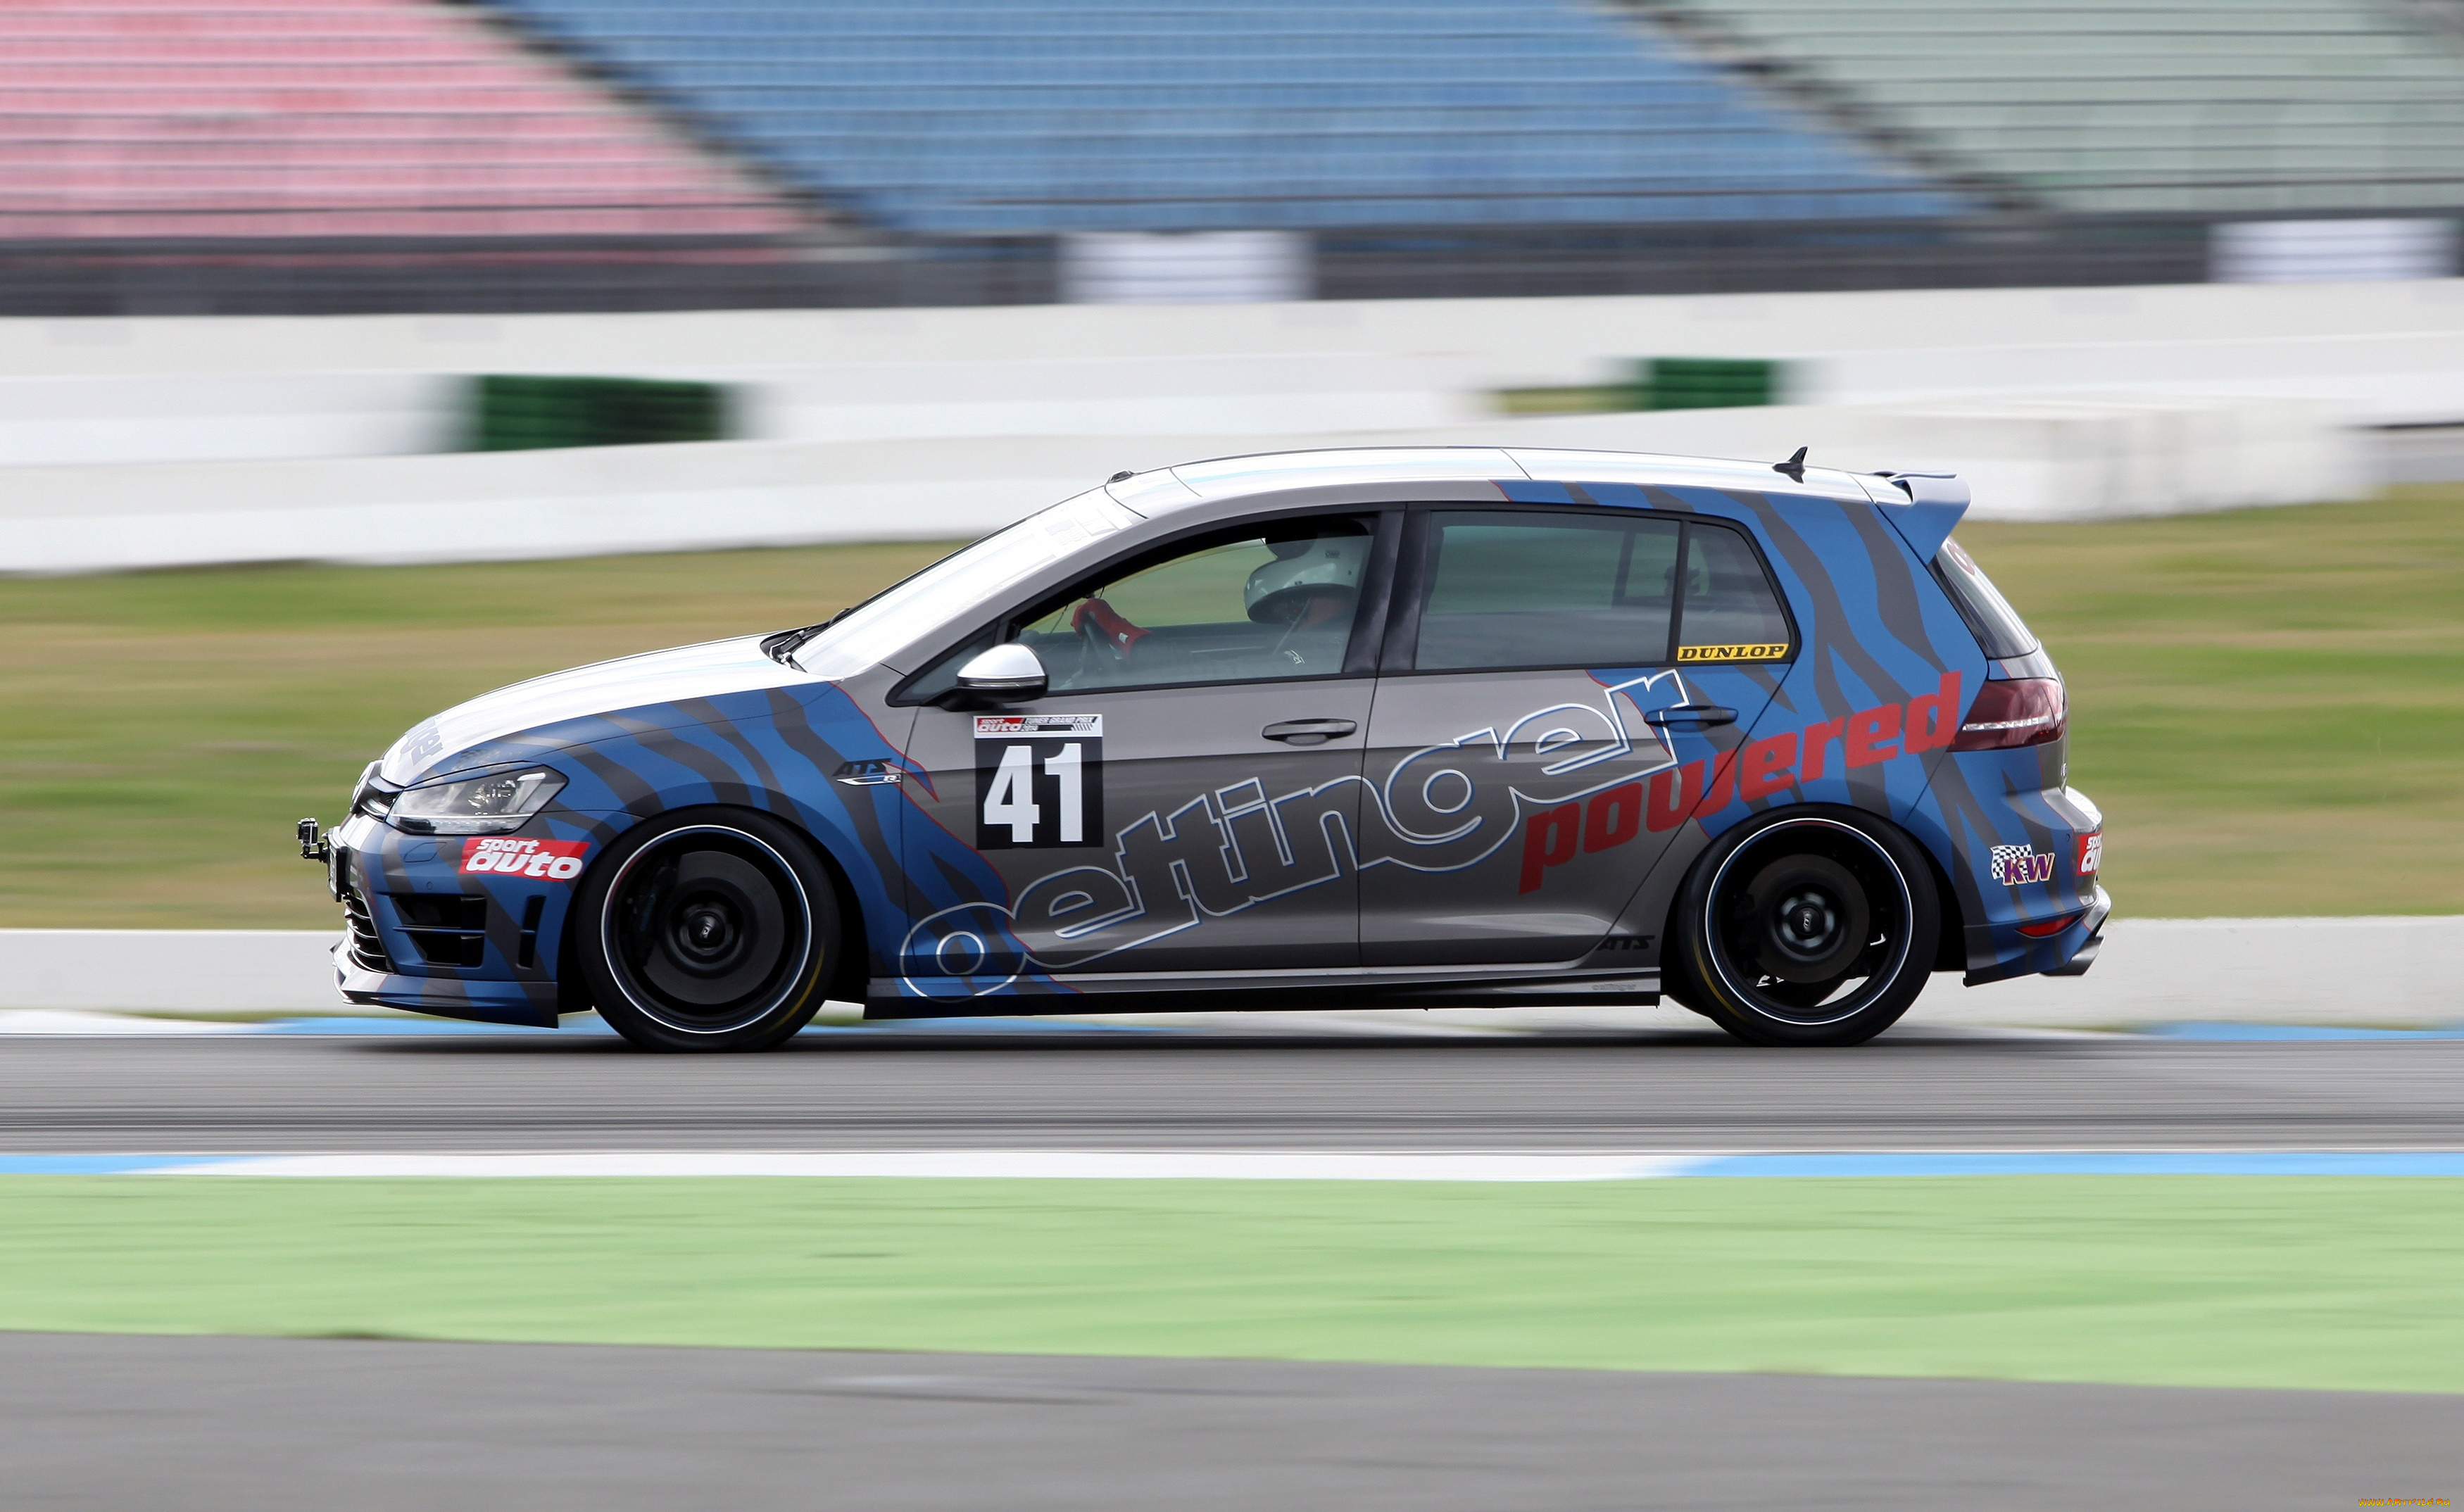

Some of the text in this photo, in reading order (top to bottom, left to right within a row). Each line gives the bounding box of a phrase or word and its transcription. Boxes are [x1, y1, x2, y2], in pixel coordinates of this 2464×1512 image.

[1679, 645, 1785, 659] DUNLOP
[978, 722, 1022, 732] auto
[983, 743, 1083, 843] 41
[1519, 670, 1961, 895] powered
[476, 838, 541, 853] sport
[900, 669, 1690, 1002] oettinger
[465, 850, 583, 879] auto
[2003, 852, 2056, 886] KW
[2081, 847, 2102, 873] au
[1595, 935, 1655, 951] ATS
